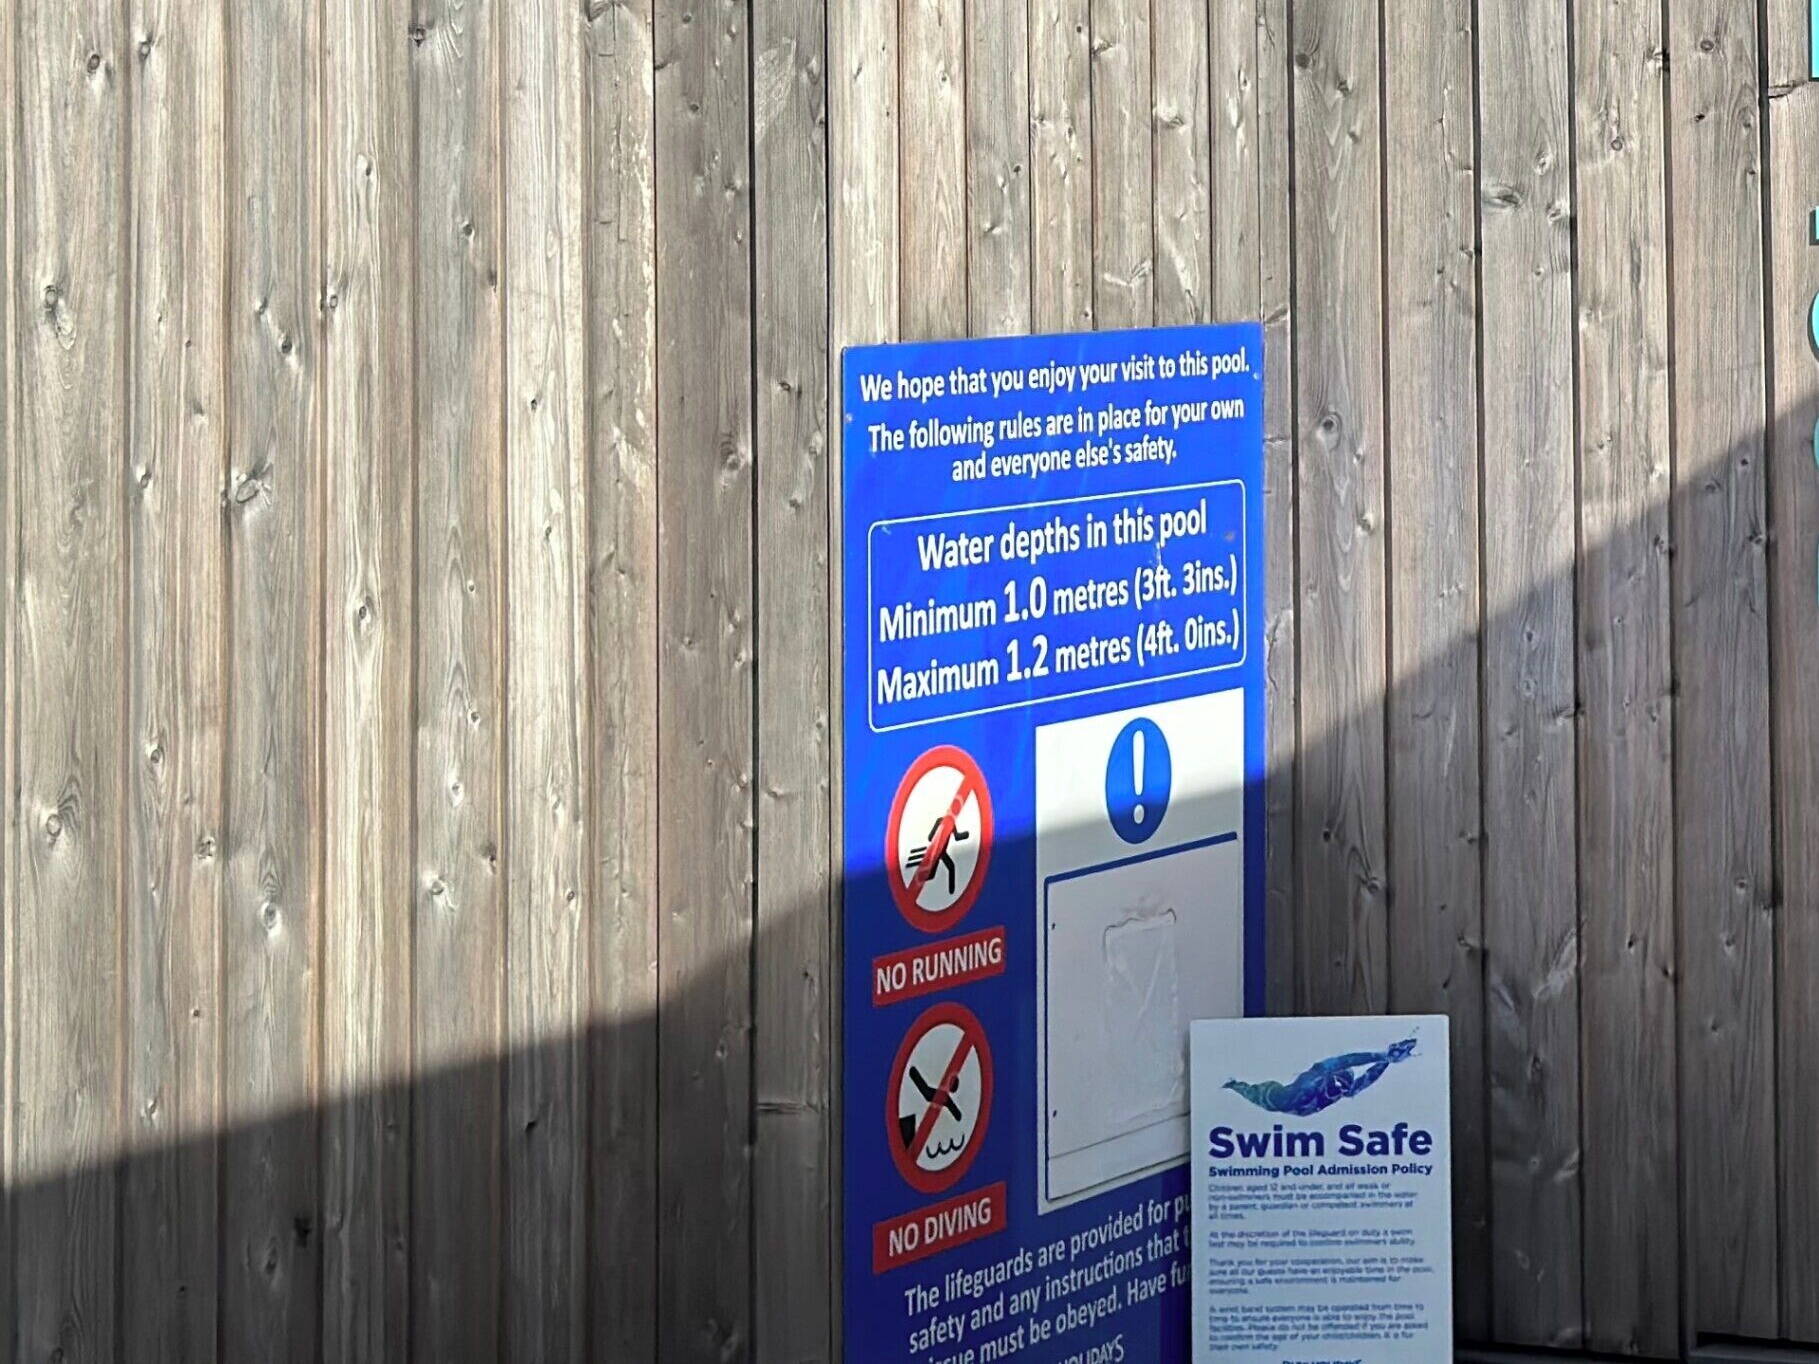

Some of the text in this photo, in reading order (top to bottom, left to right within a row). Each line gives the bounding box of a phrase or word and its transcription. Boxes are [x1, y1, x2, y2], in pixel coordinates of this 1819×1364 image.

[860, 346, 1250, 404] We hope that you enjoy your visit to this pool.
[867, 398, 1244, 452] The following rules are in place for your own
[952, 434, 1177, 481] and everyone else's safety.
[917, 498, 1207, 571] Water depths in this pool
[879, 554, 1237, 643] Minimum 1.0 metres (3ft. 3ins.)
[877, 608, 1240, 705] Maximum 1.2 metres (4ft. 0ins.)
[877, 937, 1002, 995] NO RUNNING
[1208, 1122, 1433, 1159] Swim Safe
[1208, 1163, 1433, 1179] Swimming Pool Admission Policy
[888, 1197, 992, 1257] NO DIVING
[905, 1284, 939, 1317] The
[945, 1247, 1033, 1303] lifeguards
[1038, 1240, 1066, 1267] are
[1071, 1203, 1143, 1261] provided
[1147, 1199, 1171, 1226] for
[909, 1315, 966, 1354] safety
[971, 1291, 1004, 1331] and
[1009, 1285, 1041, 1314] any
[1046, 1247, 1143, 1302] instructions
[1147, 1228, 1180, 1261] that
[980, 1325, 1025, 1364] must
[1029, 1318, 1051, 1345] be
[1056, 1285, 1122, 1334] obeyed.
[1127, 1273, 1167, 1306] Have
[1058, 1334, 1125, 1364] LIDAYS
